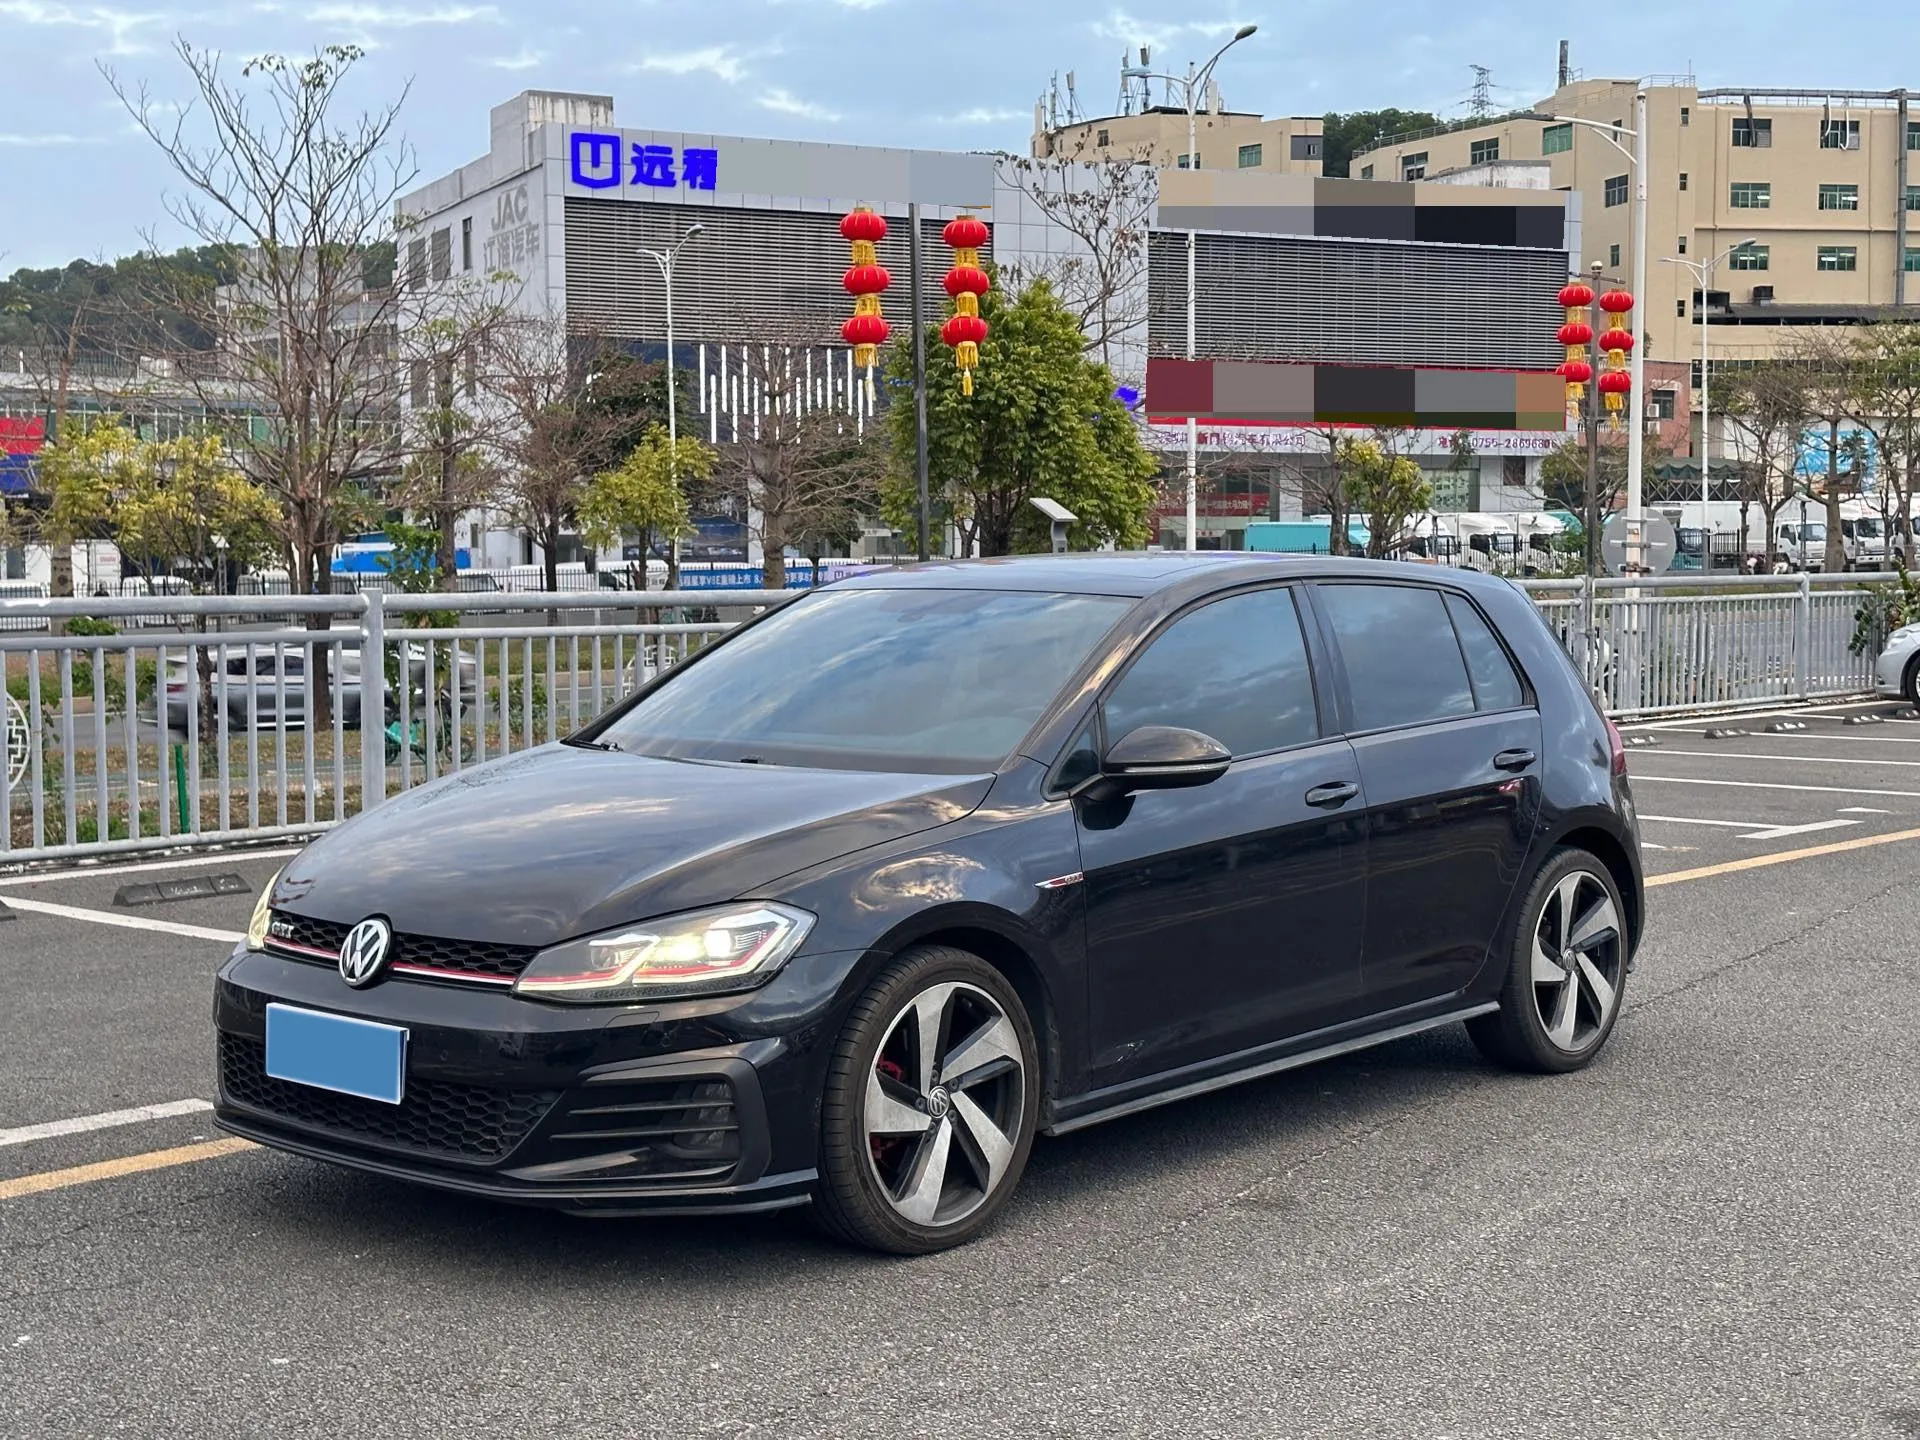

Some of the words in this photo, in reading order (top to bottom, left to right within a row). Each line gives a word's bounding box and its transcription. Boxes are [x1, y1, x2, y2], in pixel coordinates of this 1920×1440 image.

[491, 184, 528, 231] JAC
[483, 222, 540, 274] 江淮汽车
[271, 921, 294, 938] GTI
